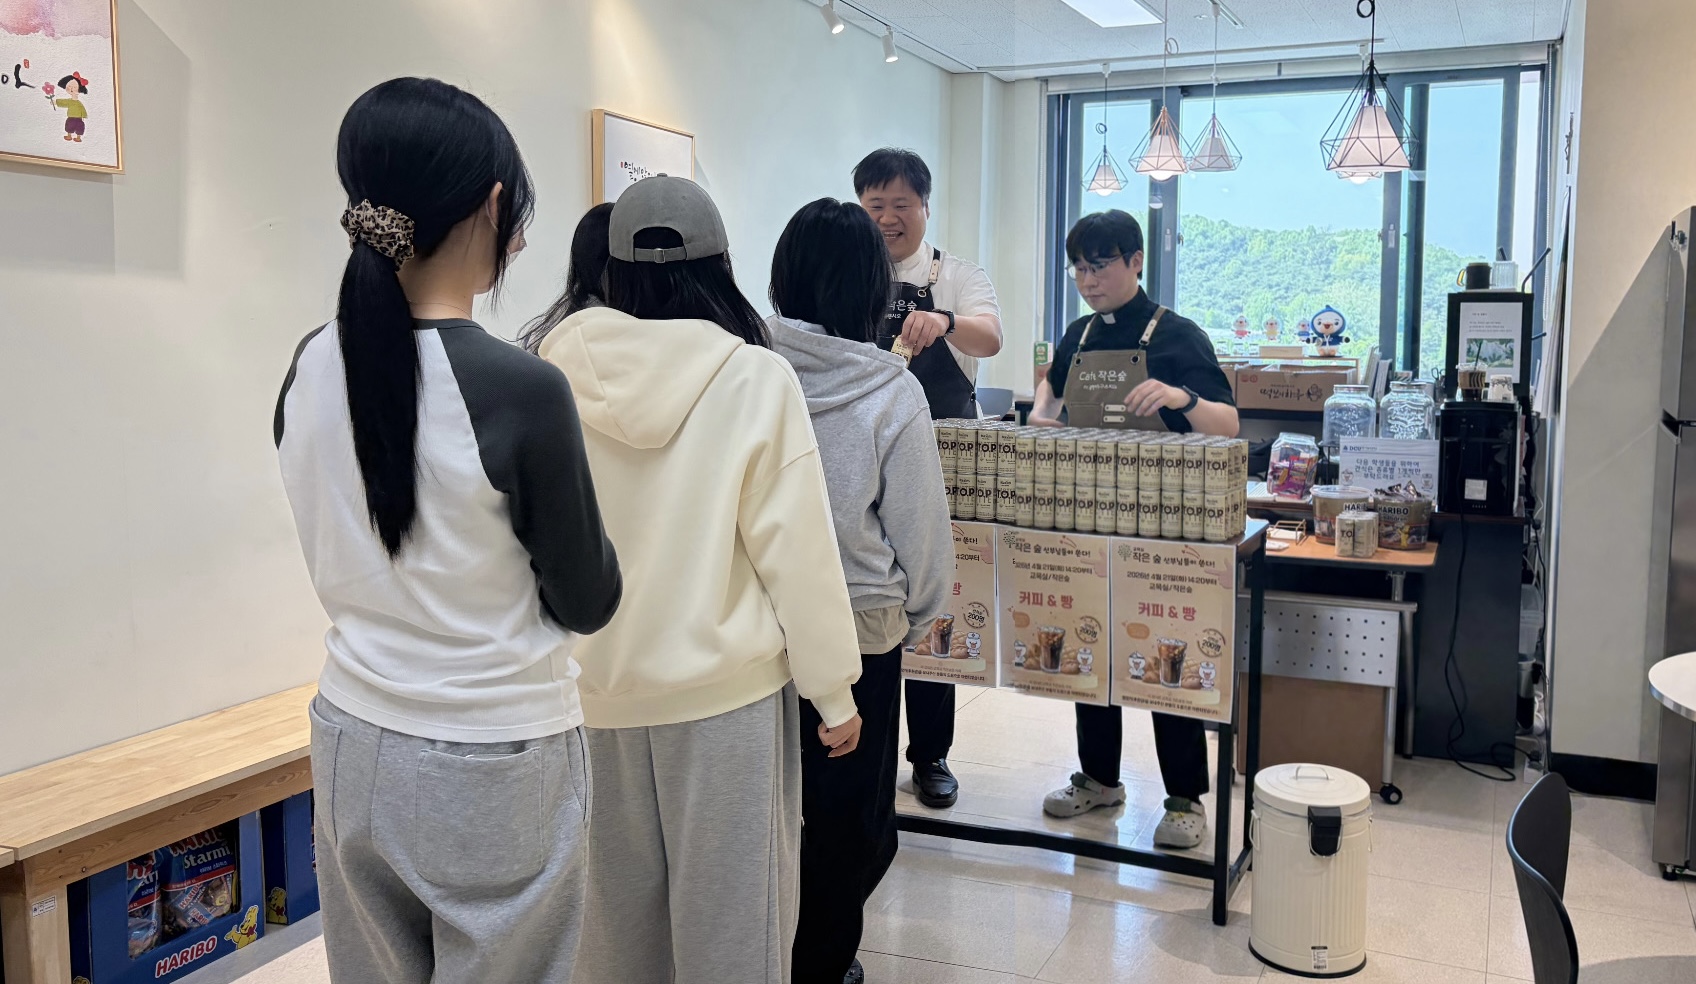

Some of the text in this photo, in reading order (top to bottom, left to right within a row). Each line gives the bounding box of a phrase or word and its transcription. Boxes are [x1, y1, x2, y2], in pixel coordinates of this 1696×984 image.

[1079, 370, 1127, 381] Cafe 작은숲
[1206, 460, 1228, 471] T.O.P
[1372, 459, 1397, 467] 학생들을
[1378, 505, 1409, 515] HARIBO
[1014, 542, 1031, 553] 작은
[1034, 544, 1041, 554] 숲
[955, 553, 980, 561] 4:20부터
[1132, 552, 1150, 563] 작은
[1153, 554, 1161, 564] 숲
[1163, 557, 1197, 567] 신부님들이
[1032, 562, 1041, 570] 4월
[1043, 563, 1065, 572] 21일(화)
[1030, 572, 1070, 582] 교목실/작은숲
[1127, 571, 1149, 580] 2026년
[1151, 572, 1161, 581] 4월
[1163, 573, 1187, 582] 21일(화)
[1149, 583, 1192, 593] 교목실/작은숲
[1019, 591, 1074, 609] 커피 & 빵
[1138, 602, 1197, 621] 커피 & 빵
[967, 612, 985, 624] 200명
[1202, 639, 1221, 652] 200명
[184, 843, 232, 869] Starmi
[155, 935, 218, 978] HARIBO
